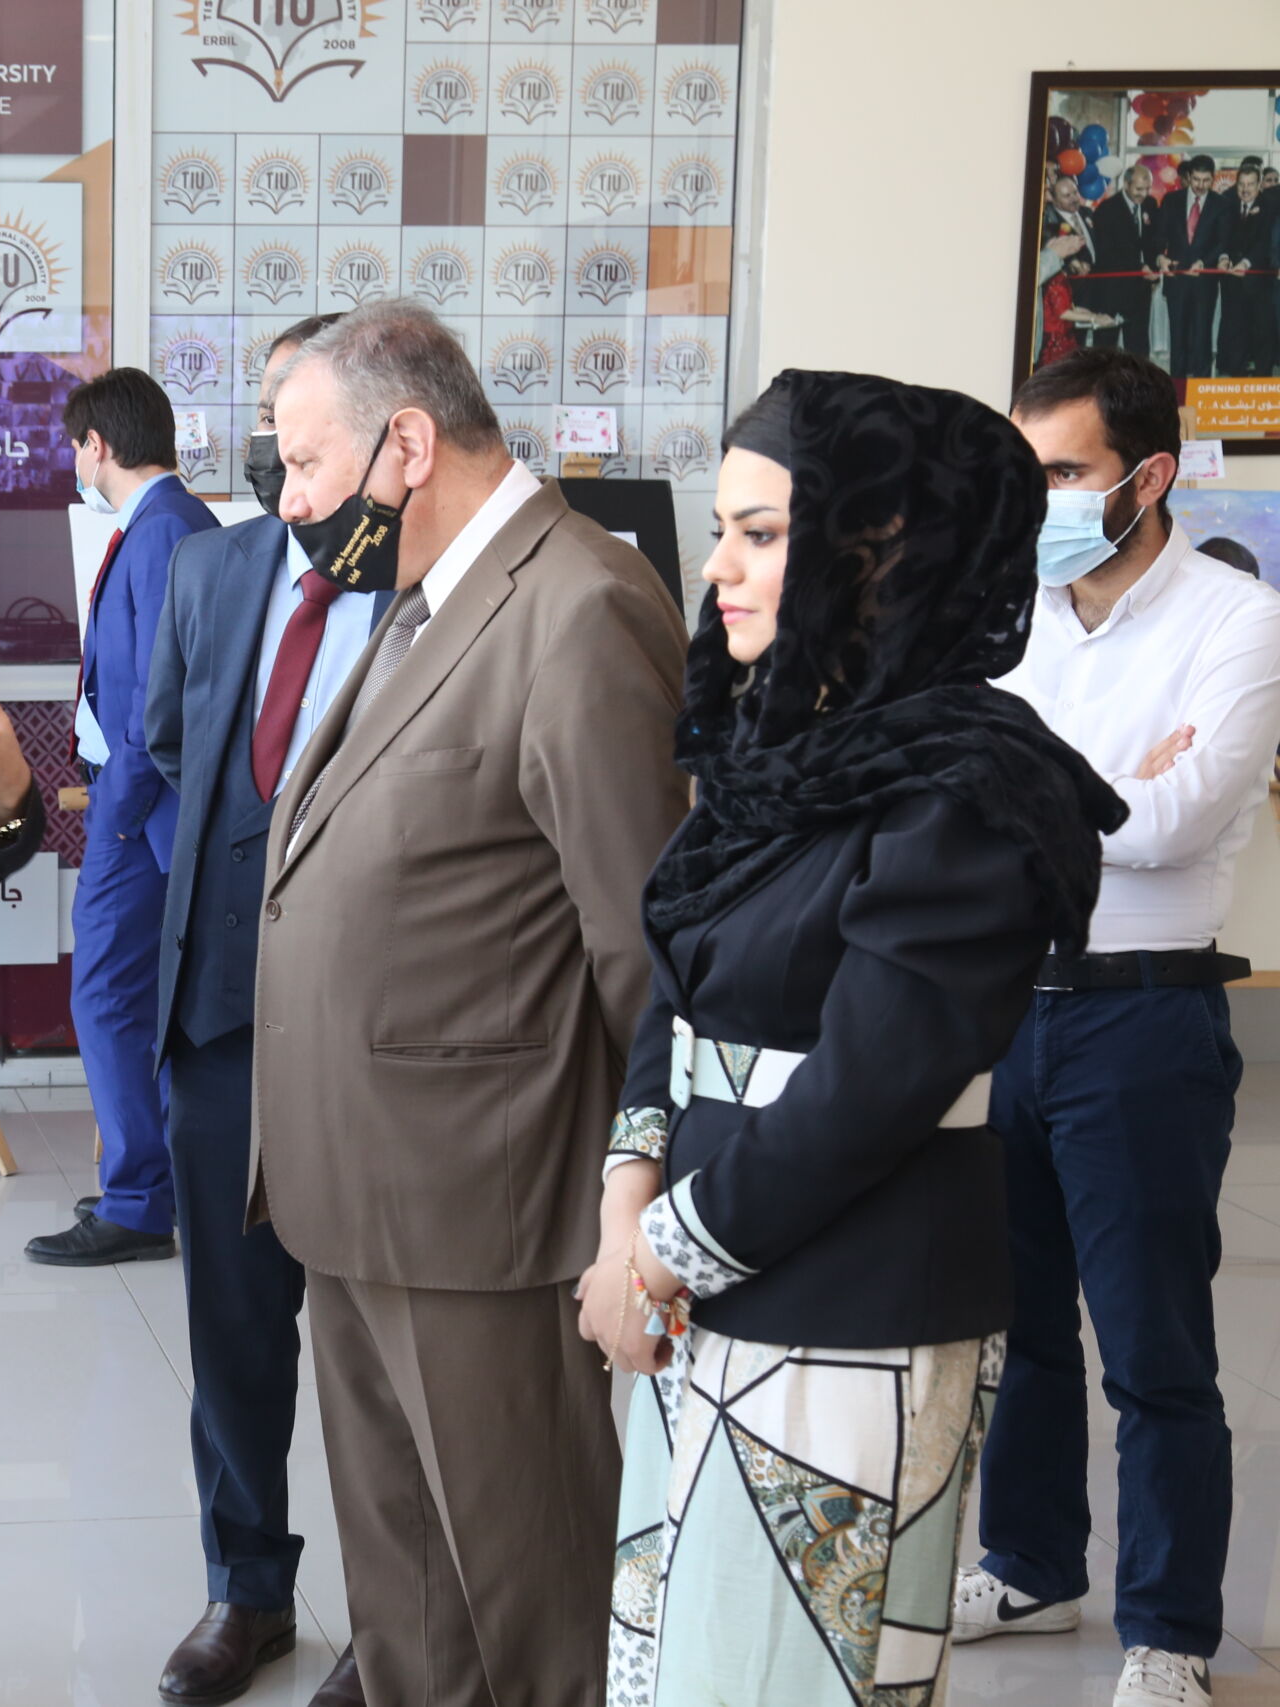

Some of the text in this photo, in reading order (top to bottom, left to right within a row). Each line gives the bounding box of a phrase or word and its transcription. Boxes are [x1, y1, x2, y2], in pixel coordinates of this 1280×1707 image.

[203, 36, 238, 46] ERBIL
[323, 40, 355, 50] 2008
[436, 81, 458, 100] TIU
[520, 82, 542, 100] TIU
[603, 83, 625, 101] TIU
[686, 83, 708, 101] TIU
[182, 172, 205, 190] TIU
[266, 172, 289, 190] TIU
[350, 172, 373, 191] TIU
[516, 174, 539, 192] TIU
[599, 174, 621, 192] TIU
[682, 174, 704, 192] TIU
[181, 262, 204, 281] TIU
[265, 263, 288, 281] TIU
[348, 263, 371, 281] TIU
[431, 264, 453, 281] TIU
[513, 264, 536, 281] TIU
[596, 264, 618, 282] TIU
[180, 353, 203, 370] TIU
[511, 353, 534, 371] TIU
[593, 353, 615, 370] TIU
[675, 353, 696, 371] TIU
[1243, 384, 1280, 393] CEREMO
[509, 441, 531, 458] TIU
[672, 440, 694, 458] TIU
[373, 525, 388, 546] 2008
